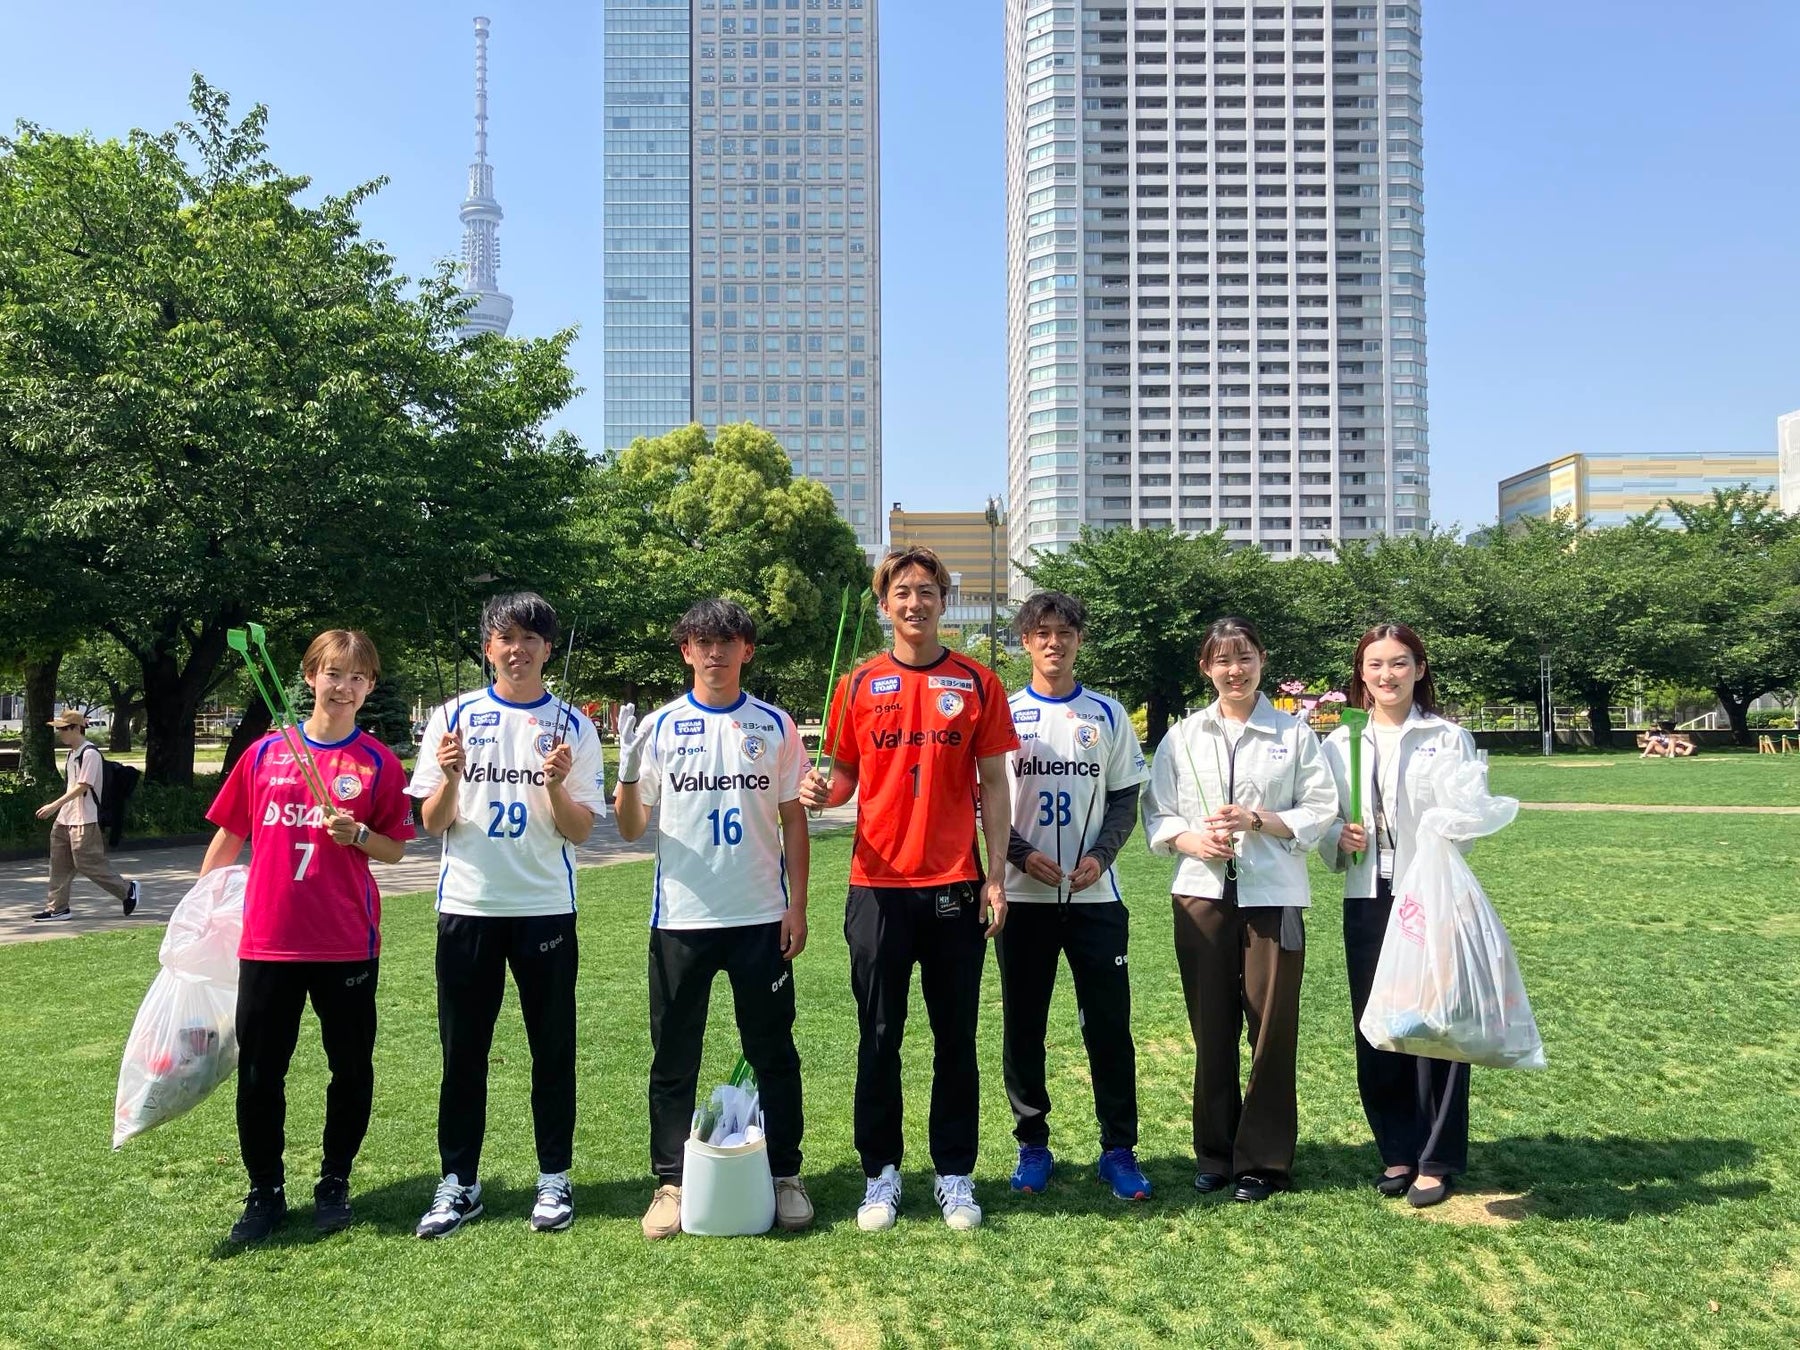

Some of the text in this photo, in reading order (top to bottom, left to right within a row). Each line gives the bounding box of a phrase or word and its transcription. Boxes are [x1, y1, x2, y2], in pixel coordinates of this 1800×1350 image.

[871, 728, 962, 749] Valuence
[669, 771, 770, 792] Valuence
[910, 764, 921, 798] 1
[1011, 757, 1100, 777] Valuence
[487, 801, 528, 838] 29
[707, 808, 743, 846] 16
[294, 843, 315, 881] 7
